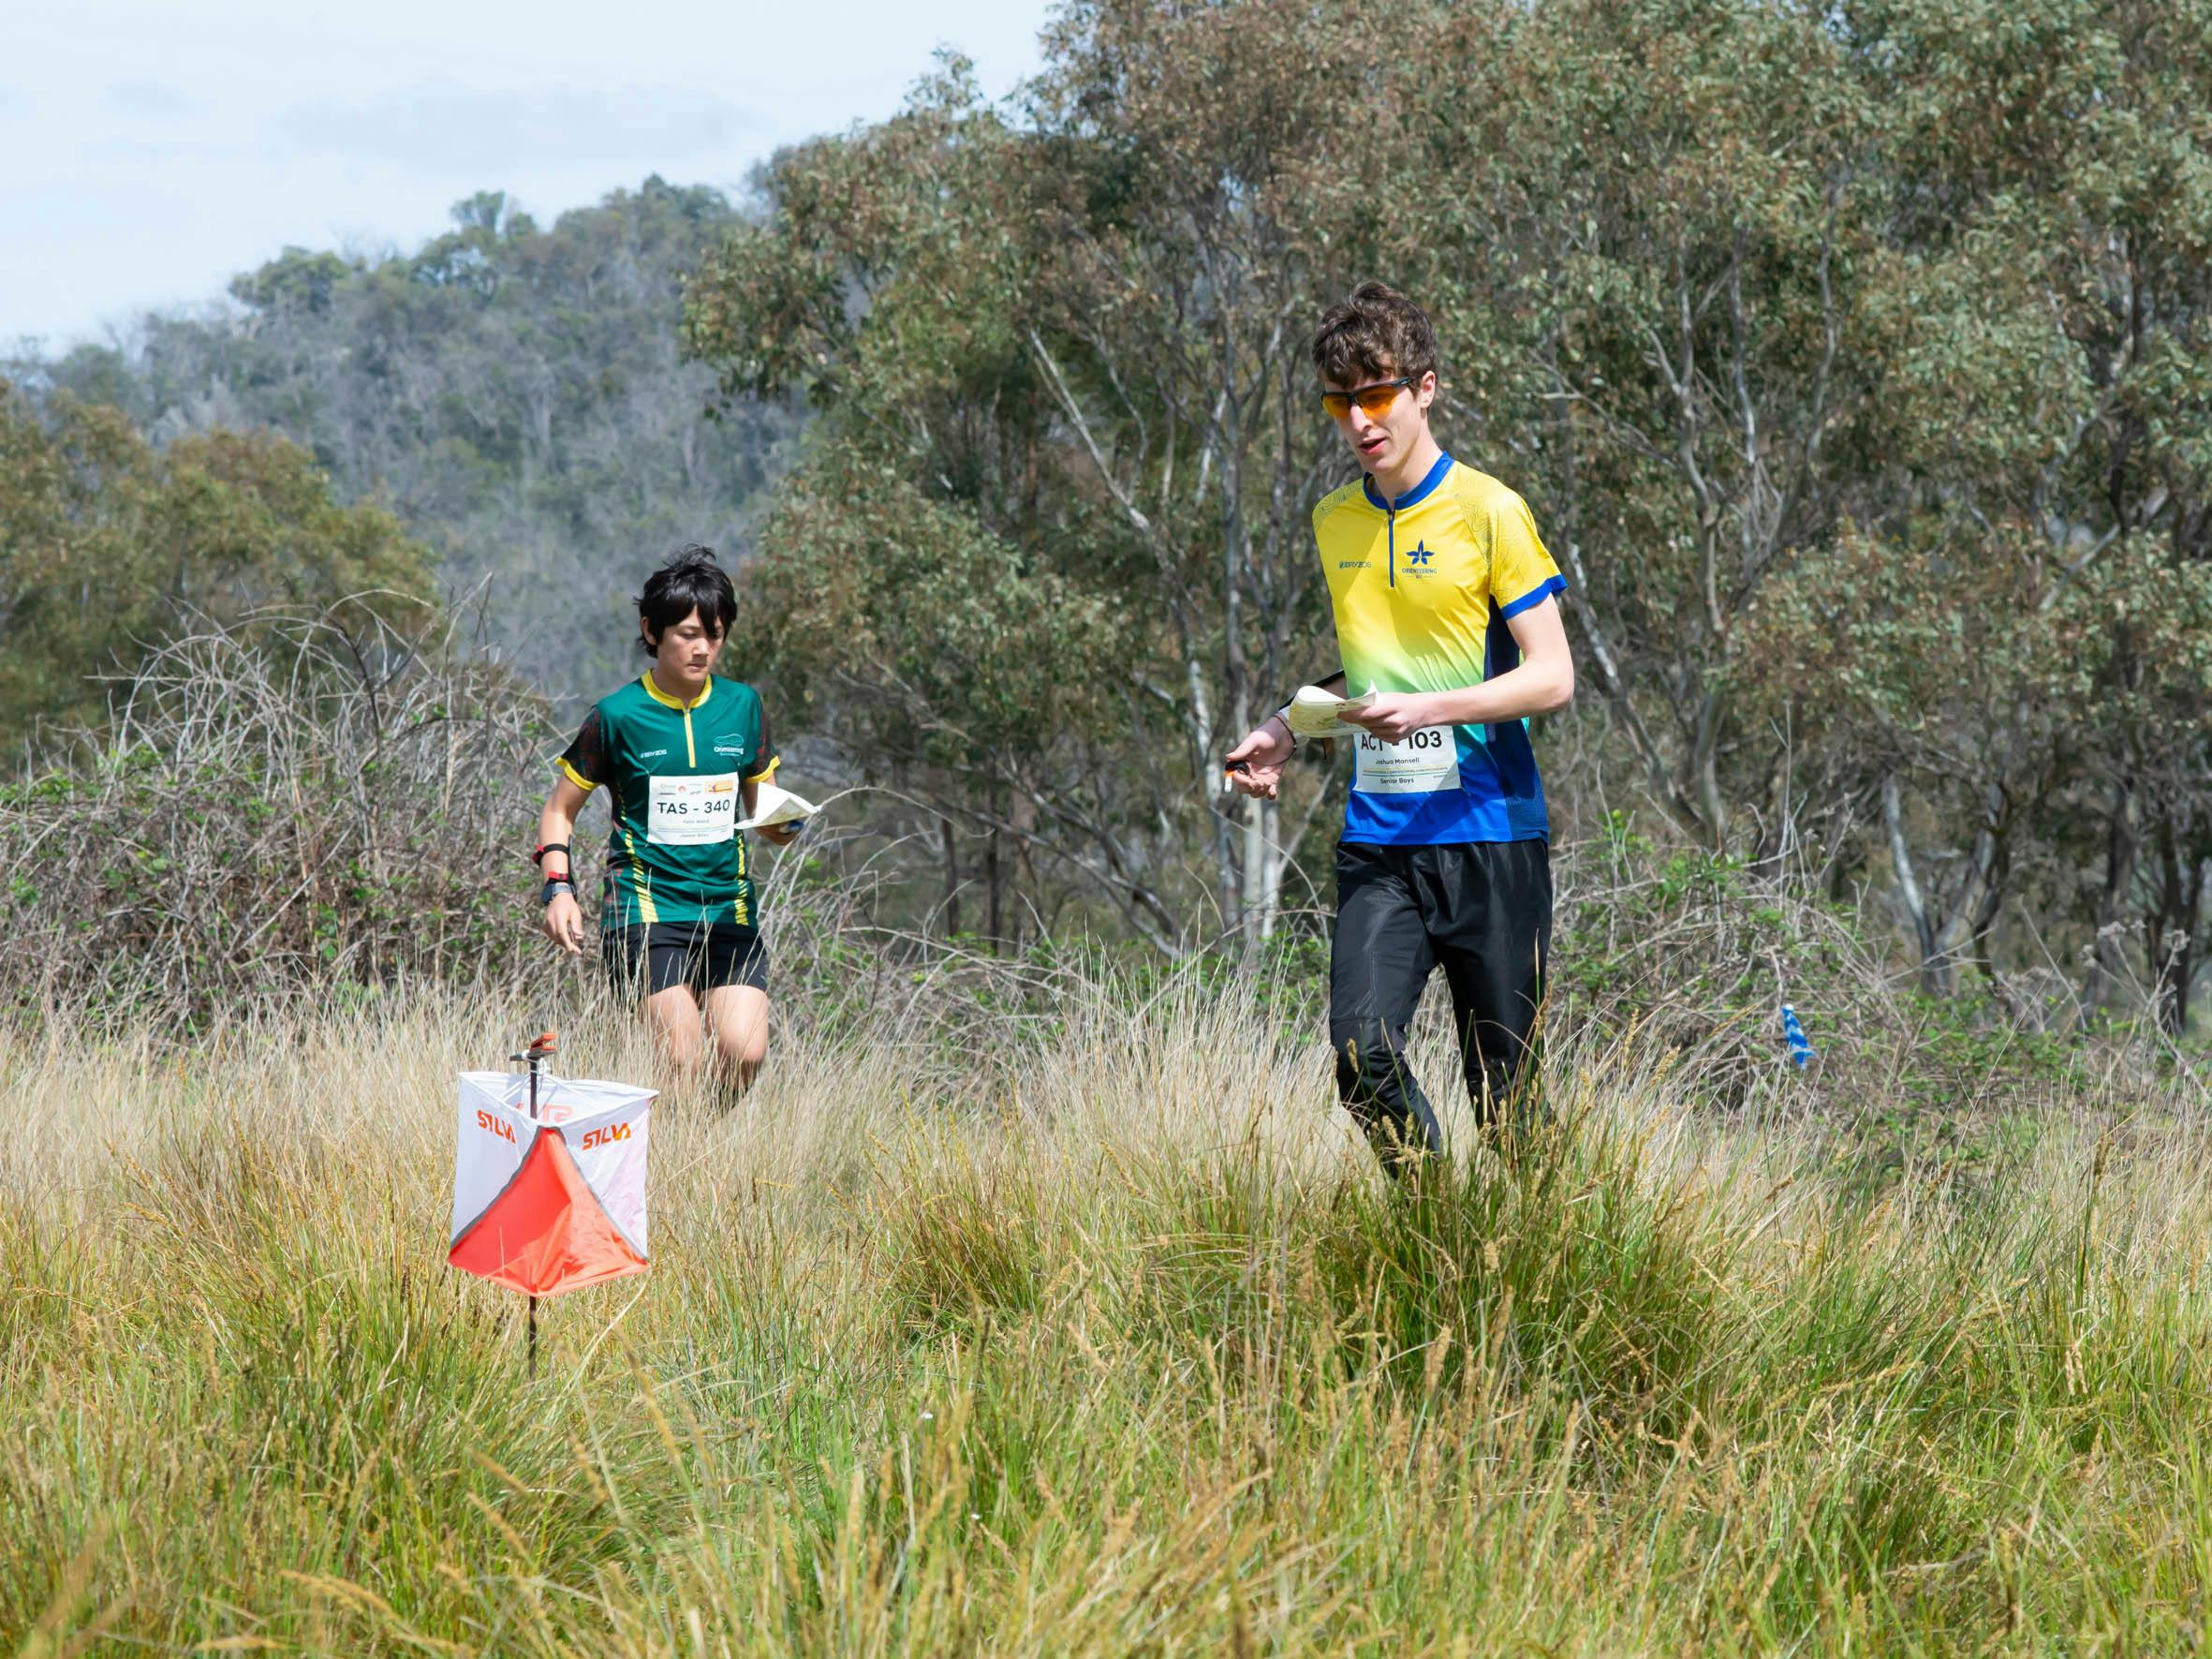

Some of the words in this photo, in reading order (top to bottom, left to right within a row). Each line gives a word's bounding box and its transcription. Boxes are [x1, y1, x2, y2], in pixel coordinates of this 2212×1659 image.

[1408, 731, 1442, 749] 103
[656, 802, 688, 815] TAS
[704, 799, 730, 814] 340
[476, 1109, 517, 1145] SILVA
[582, 1122, 632, 1151] SILVA
